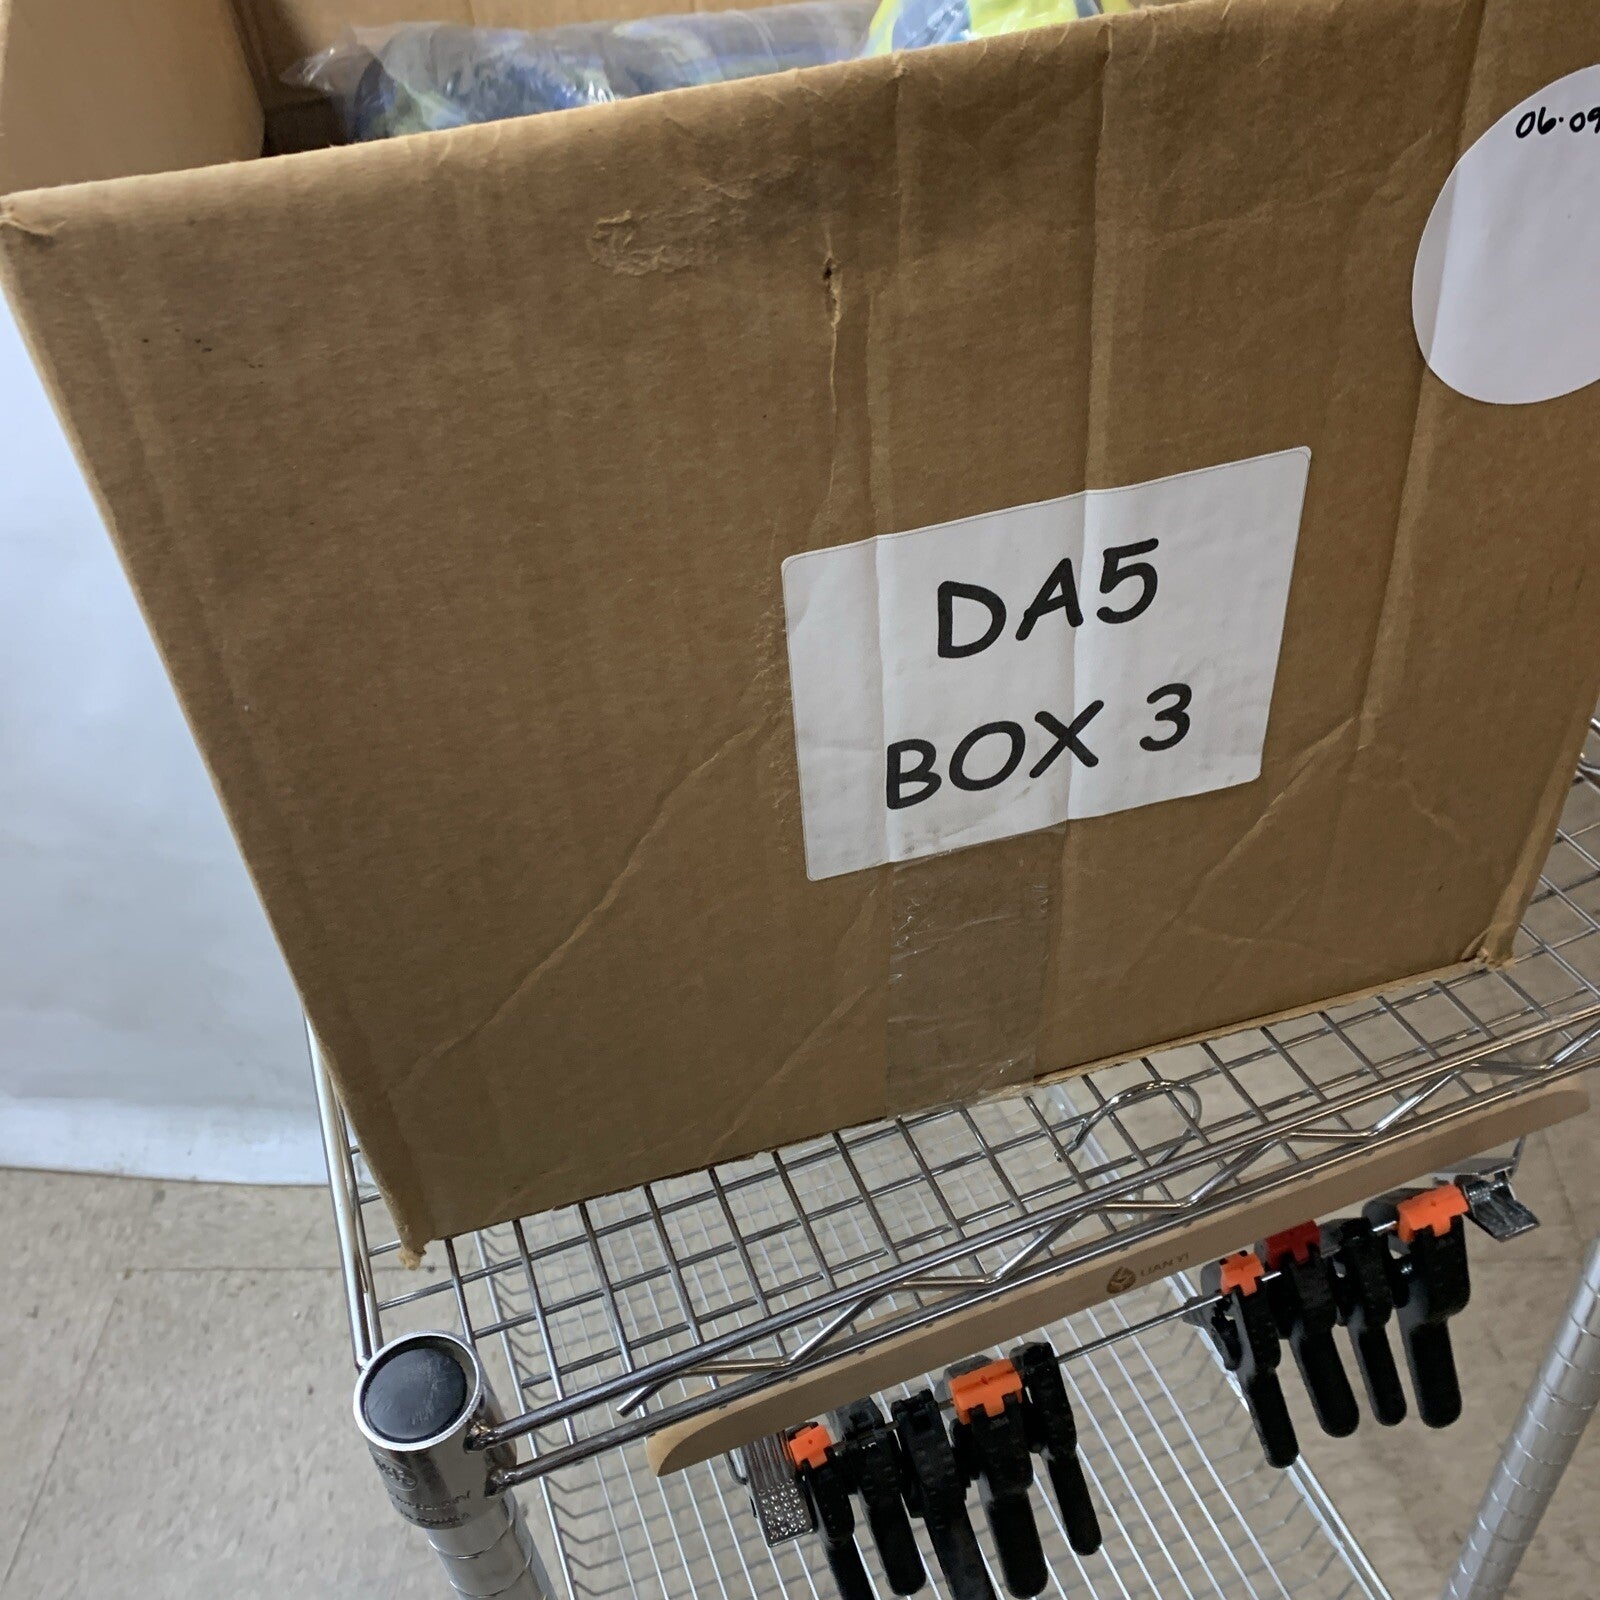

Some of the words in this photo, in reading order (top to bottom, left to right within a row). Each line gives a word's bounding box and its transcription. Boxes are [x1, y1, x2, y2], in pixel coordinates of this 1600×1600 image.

[938, 538, 1159, 658] DA5
[886, 700, 1104, 810] BOX
[1139, 682, 1193, 751] 3
